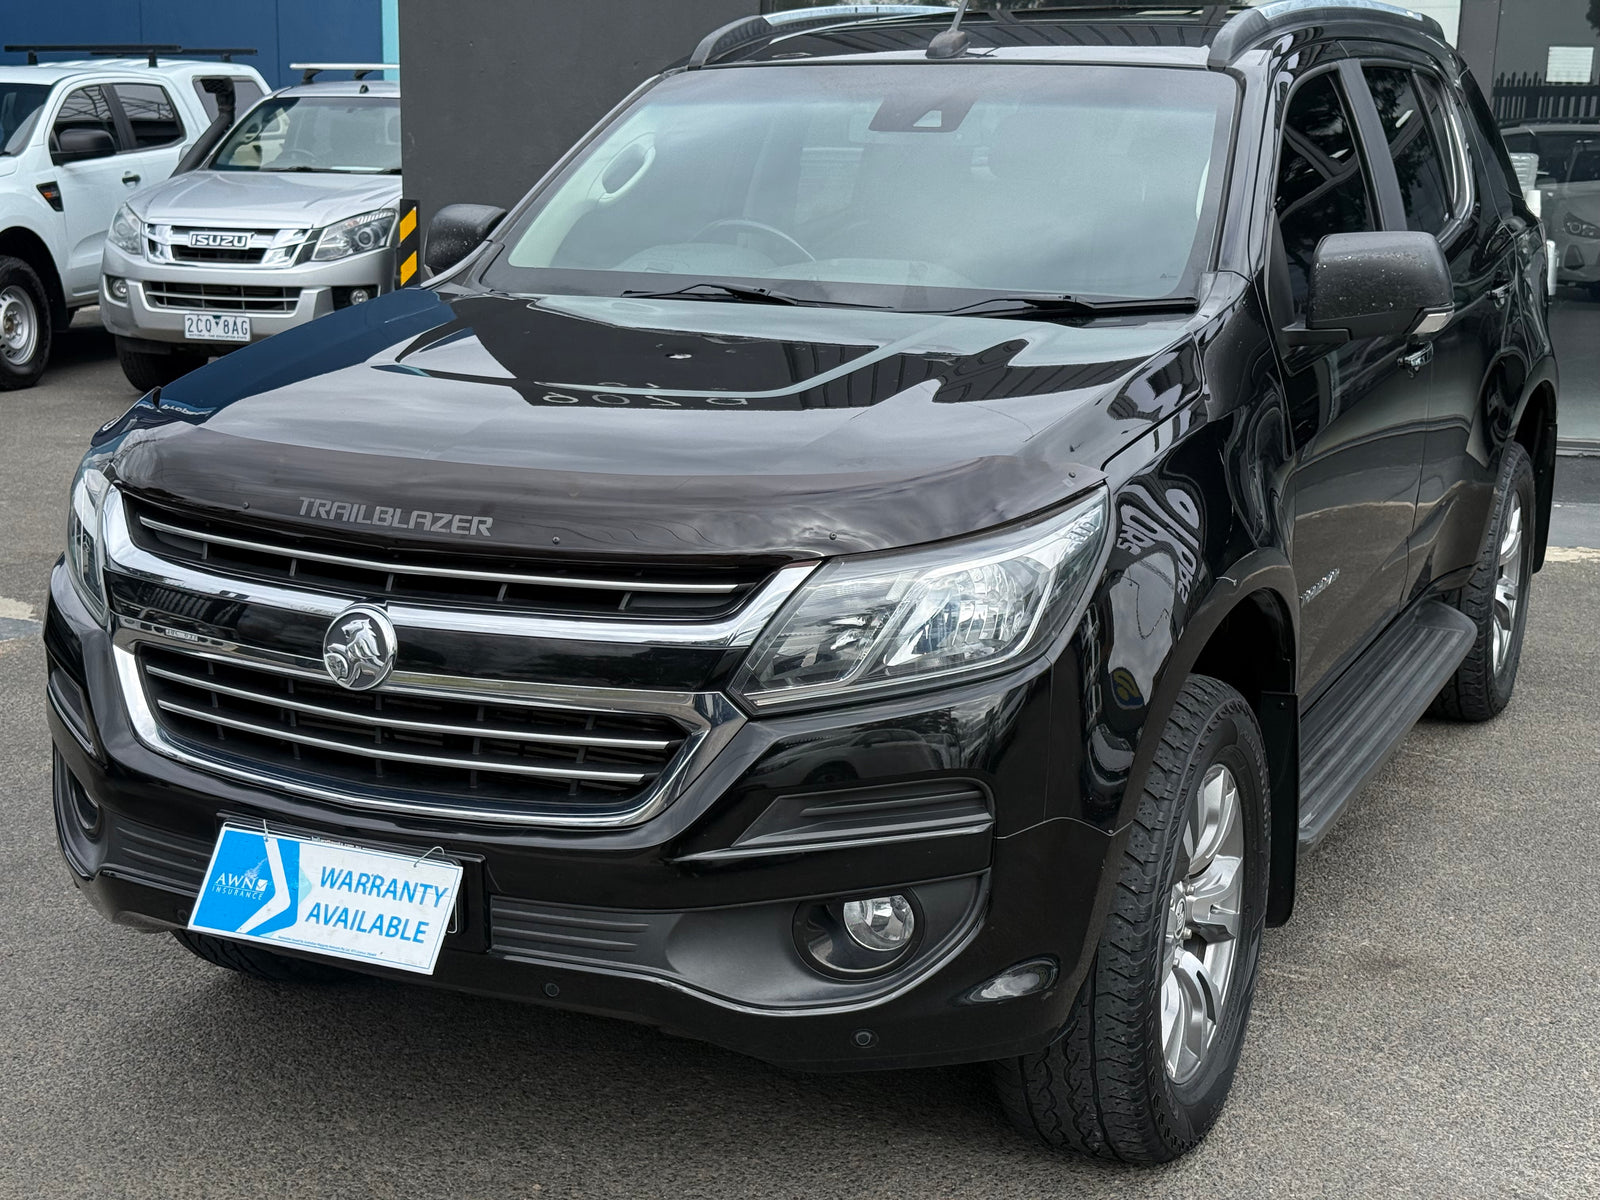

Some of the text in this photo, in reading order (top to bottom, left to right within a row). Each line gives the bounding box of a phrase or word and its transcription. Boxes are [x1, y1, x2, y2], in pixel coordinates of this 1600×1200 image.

[191, 234, 246, 247] ISUZU
[222, 319, 248, 335] 8AG
[299, 497, 493, 536] TRAILBLAZER
[215, 872, 258, 890] AWN
[320, 866, 449, 908] WARRANTY
[211, 885, 264, 900] INSURANCE
[305, 902, 430, 944] AVAILABLE
